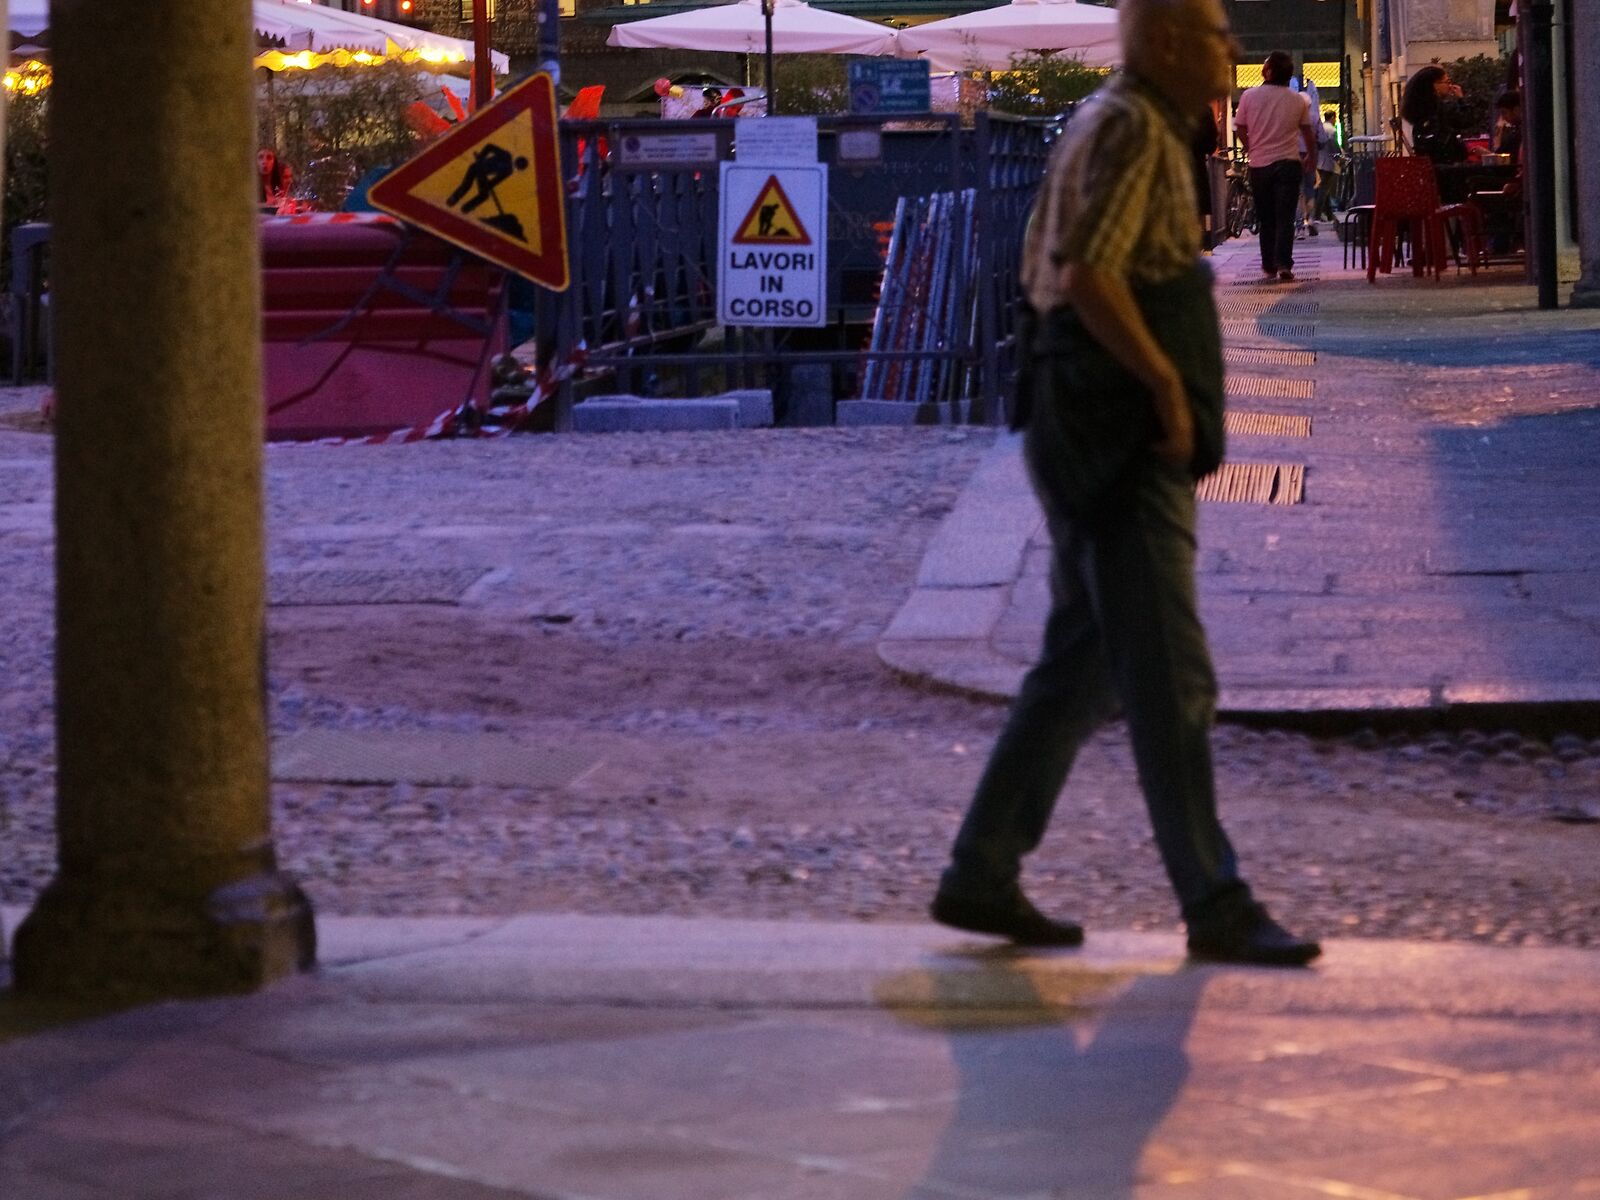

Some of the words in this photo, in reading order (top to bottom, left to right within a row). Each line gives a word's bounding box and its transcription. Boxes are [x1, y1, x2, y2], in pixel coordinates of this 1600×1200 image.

[730, 252, 815, 271] LAVORI
[760, 275, 783, 293] IN
[729, 299, 813, 318] CORSO
